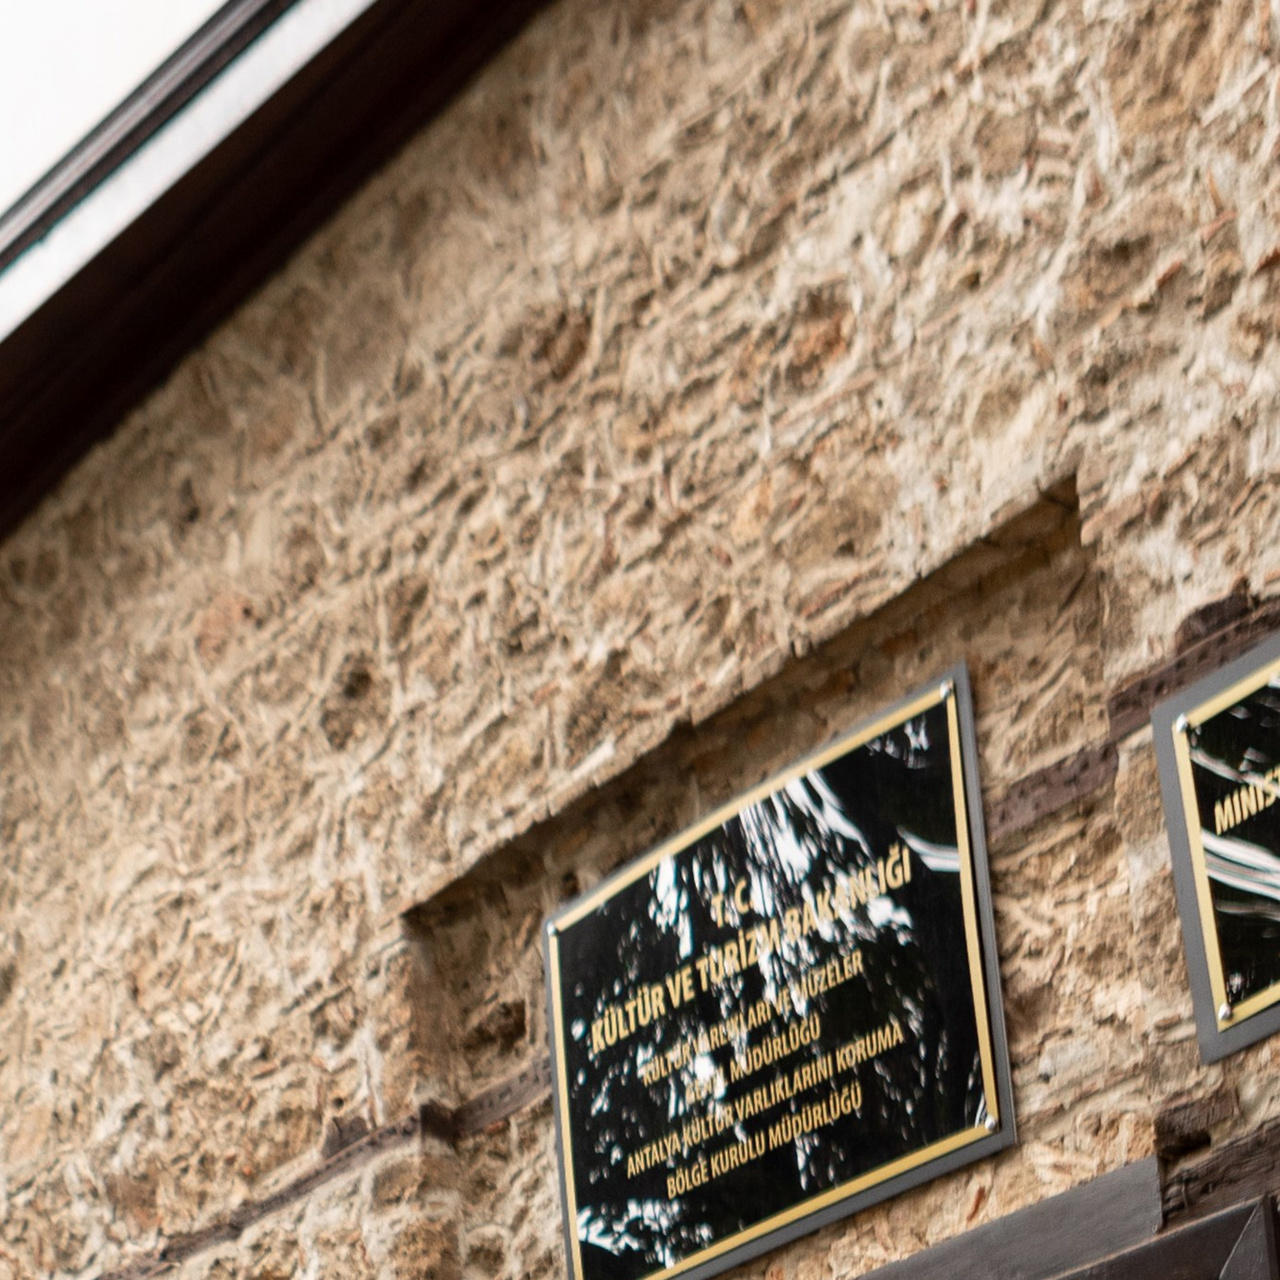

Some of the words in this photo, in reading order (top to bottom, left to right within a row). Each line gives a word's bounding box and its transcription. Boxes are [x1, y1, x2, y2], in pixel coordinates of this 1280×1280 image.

[591, 983, 666, 1053] KÜLTÜR
[666, 966, 696, 1009] VE
[696, 917, 781, 992] TURİZM
[785, 842, 912, 942] BAKANLIĞI
[774, 986, 792, 1013] VE
[794, 949, 864, 1002] MÜZELER
[626, 1133, 682, 1178] ANTALYA
[682, 1103, 734, 1149] KÜLTÜR
[735, 1057, 833, 1120] VARLIKLARINI
[836, 1022, 904, 1074] KORUMA
[729, 1011, 821, 1084] MÜDÜRLÜĞÜ
[666, 1157, 710, 1200] BÖLGE
[710, 1128, 766, 1179] KURULU
[768, 1079, 863, 1149] MÜDÜRLÜĞÜ
